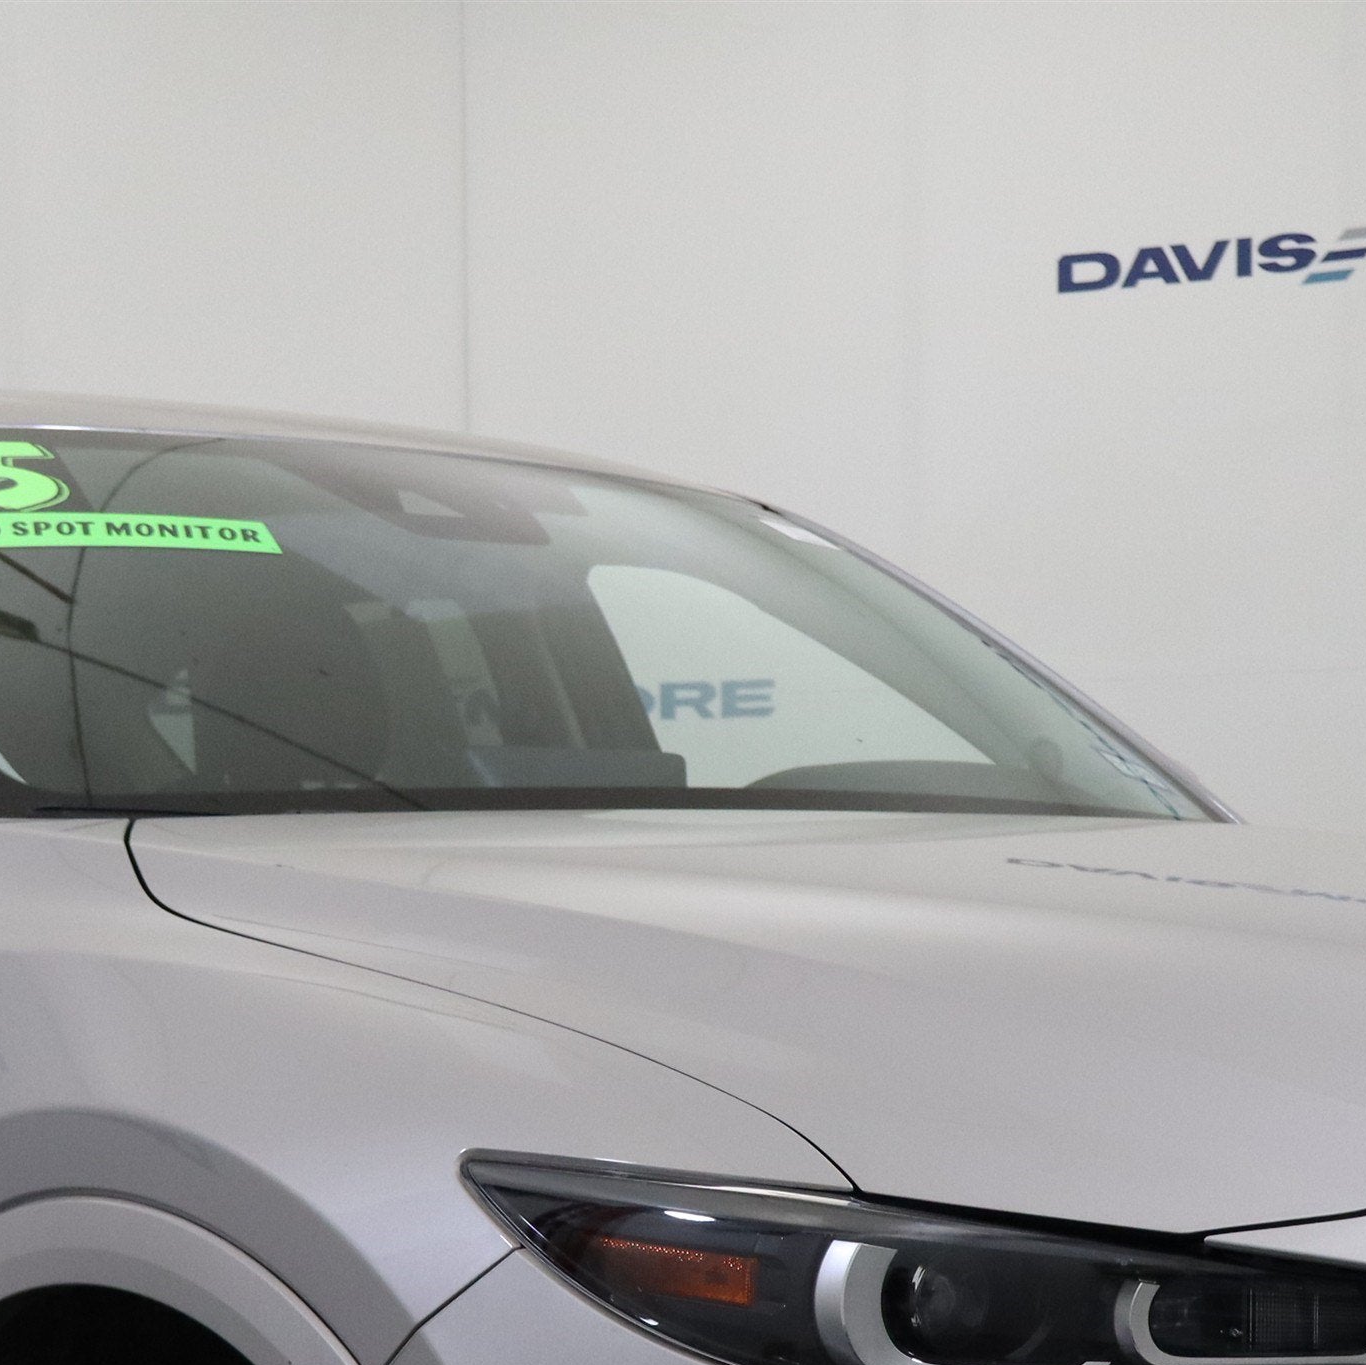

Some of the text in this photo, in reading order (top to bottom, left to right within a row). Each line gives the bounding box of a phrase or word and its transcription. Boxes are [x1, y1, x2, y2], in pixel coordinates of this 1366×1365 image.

[1057, 232, 1317, 294] DAVIS
[12, 520, 93, 538] SPOT
[106, 520, 263, 543] MONITOR
